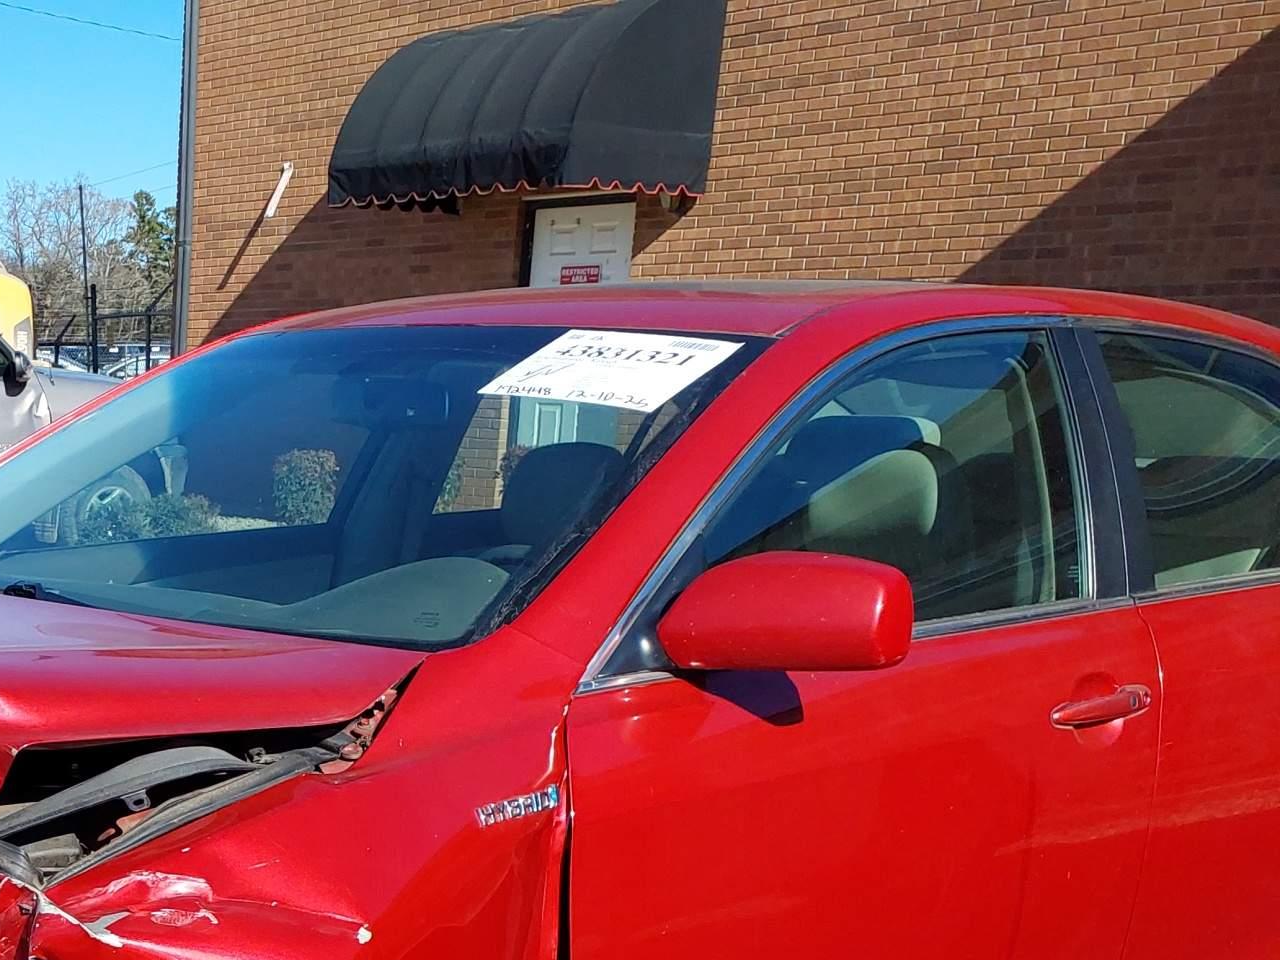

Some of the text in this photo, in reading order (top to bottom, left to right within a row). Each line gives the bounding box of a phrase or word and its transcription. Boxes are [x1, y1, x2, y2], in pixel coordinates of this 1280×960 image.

[561, 267, 599, 276] RESTRICTED
[571, 274, 588, 282] AREA
[555, 344, 697, 366] 43831321
[474, 784, 558, 828] HYBRID
